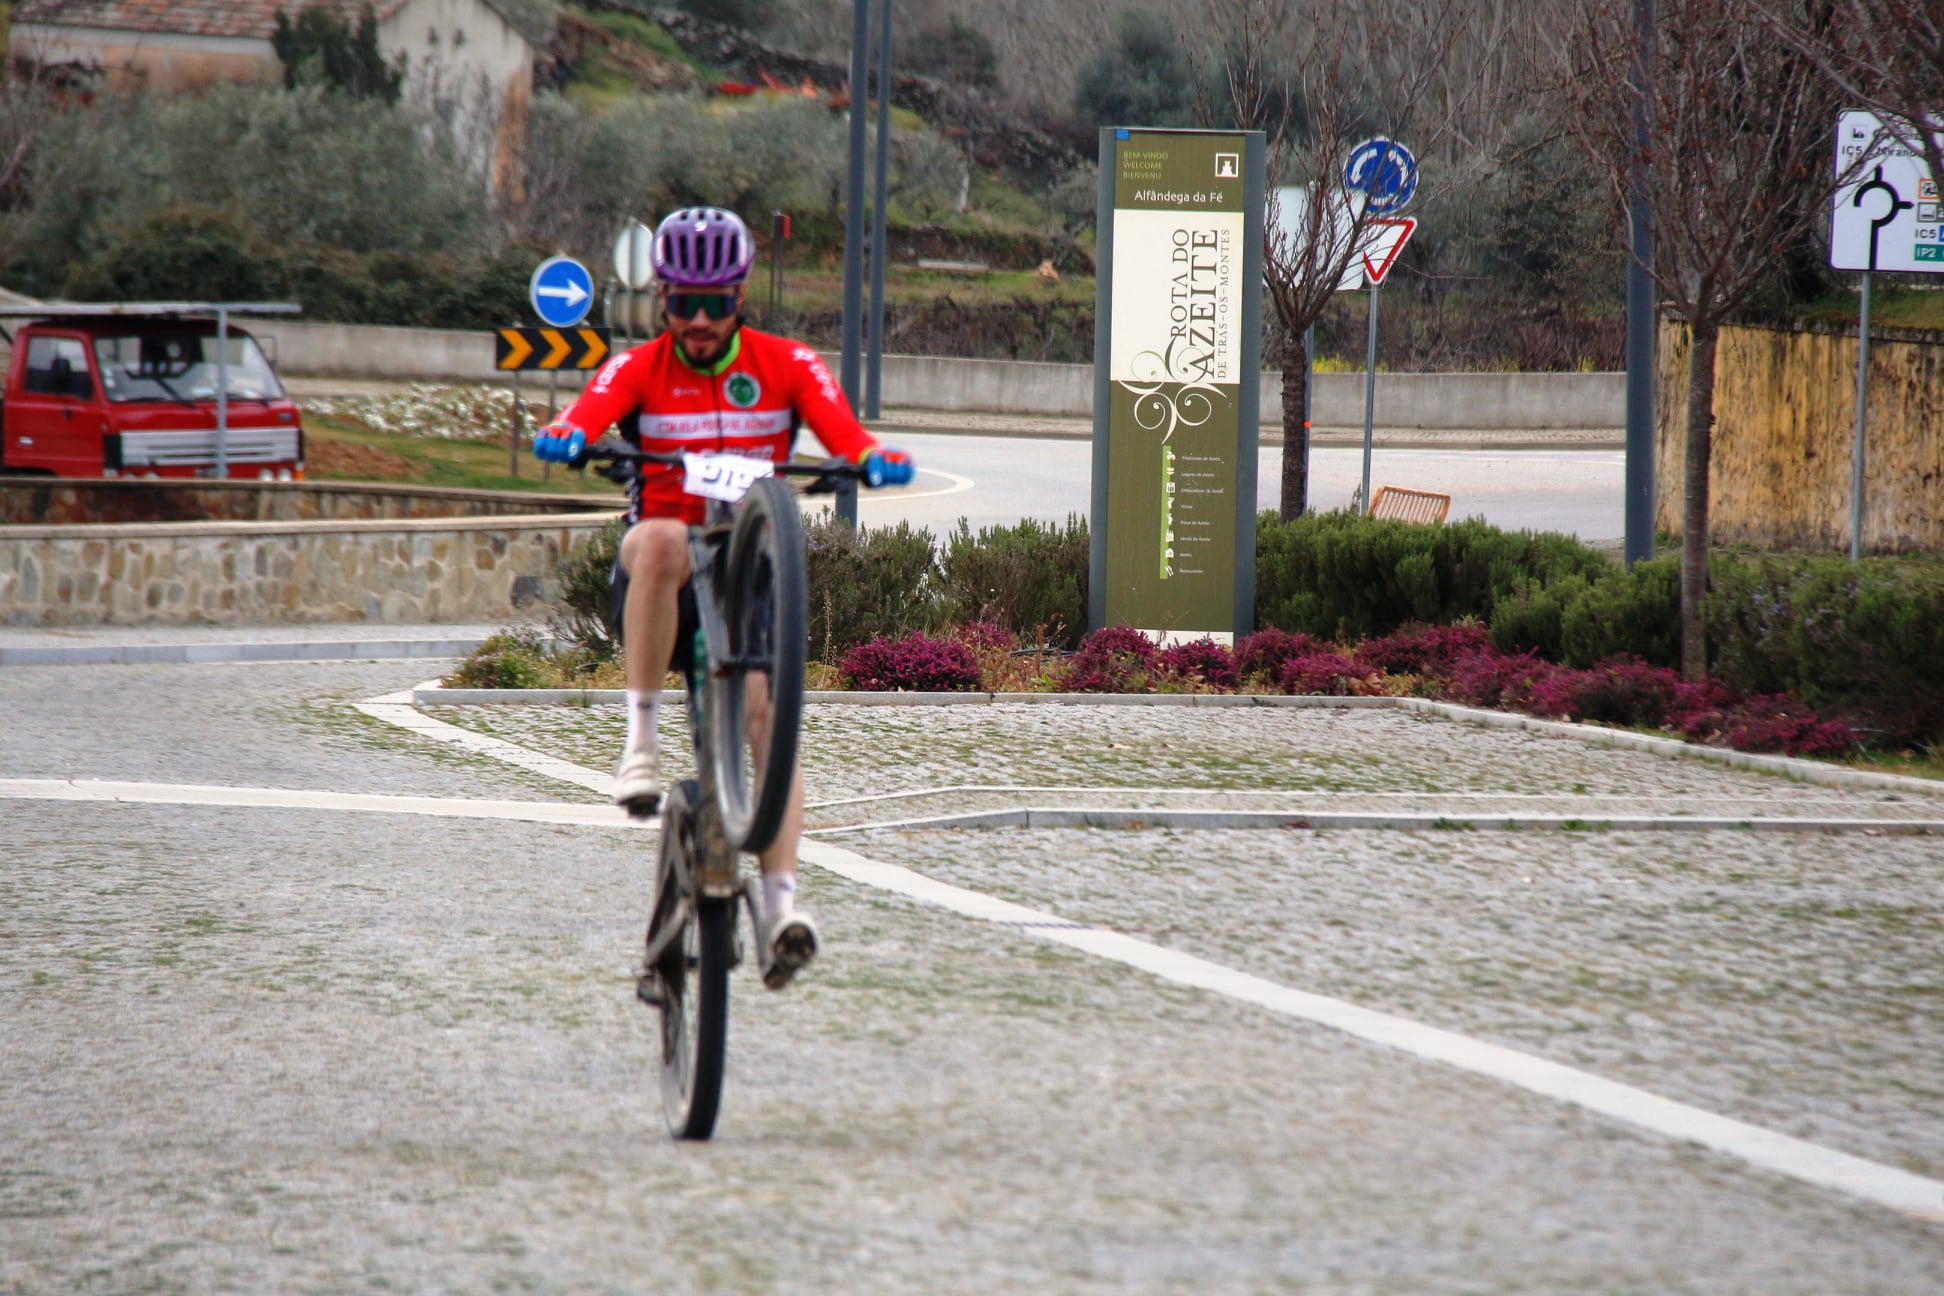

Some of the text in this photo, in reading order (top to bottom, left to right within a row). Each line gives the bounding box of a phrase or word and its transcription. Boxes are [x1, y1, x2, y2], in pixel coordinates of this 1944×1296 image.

[1123, 151, 1169, 160] BEM-VINDO
[1842, 145, 1863, 157] IC5
[1123, 161, 1163, 170] WELCOME
[1123, 171, 1162, 180] BIENVENU
[1134, 190, 1223, 204] Alfândega da Fé
[1914, 228, 1937, 239] IC5
[1916, 247, 1936, 258] IP2
[1170, 228, 1190, 338] ROTA DO
[1188, 228, 1218, 380] AZEITE
[1217, 361, 1227, 379] DE
